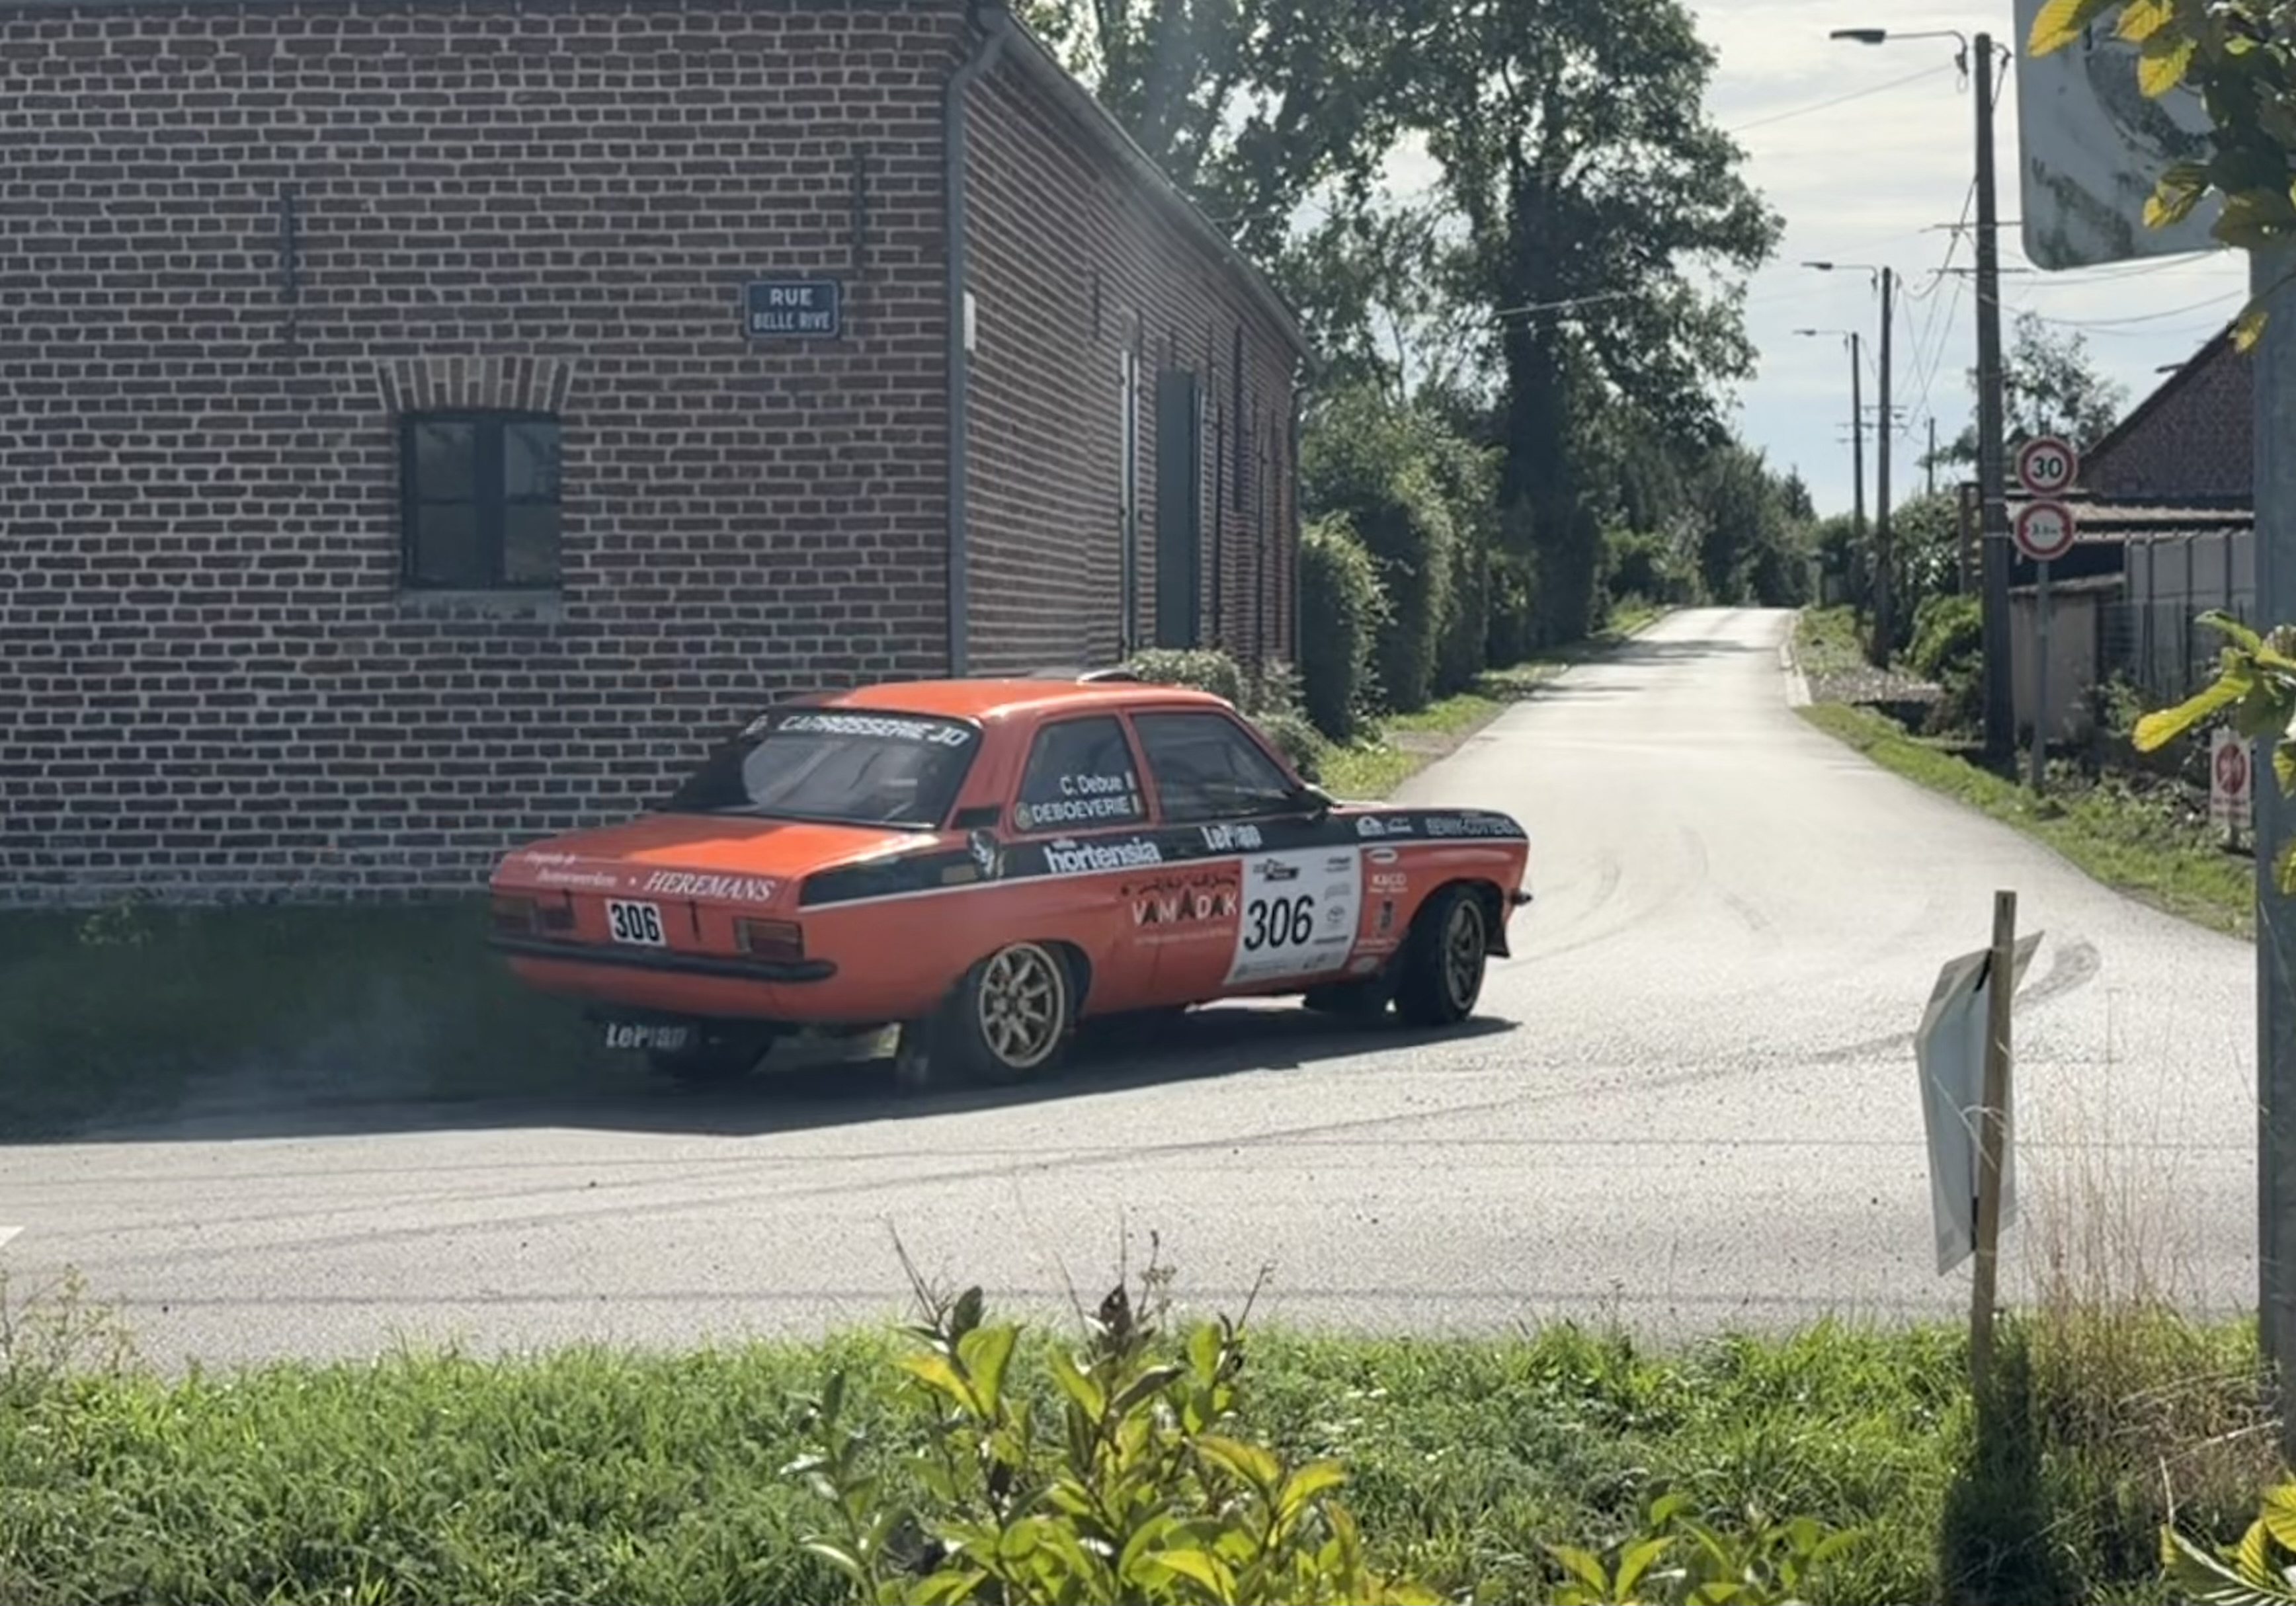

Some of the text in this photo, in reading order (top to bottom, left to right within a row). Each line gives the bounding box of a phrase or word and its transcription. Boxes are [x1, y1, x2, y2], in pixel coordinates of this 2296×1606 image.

[770, 288, 813, 306] RUE
[753, 311, 794, 329] BELLE
[2032, 456, 2063, 479] 30
[1044, 836, 1162, 873] hortensia
[643, 871, 776, 902] HEREMANS
[610, 903, 660, 942] 306
[1244, 894, 1315, 951] 306
